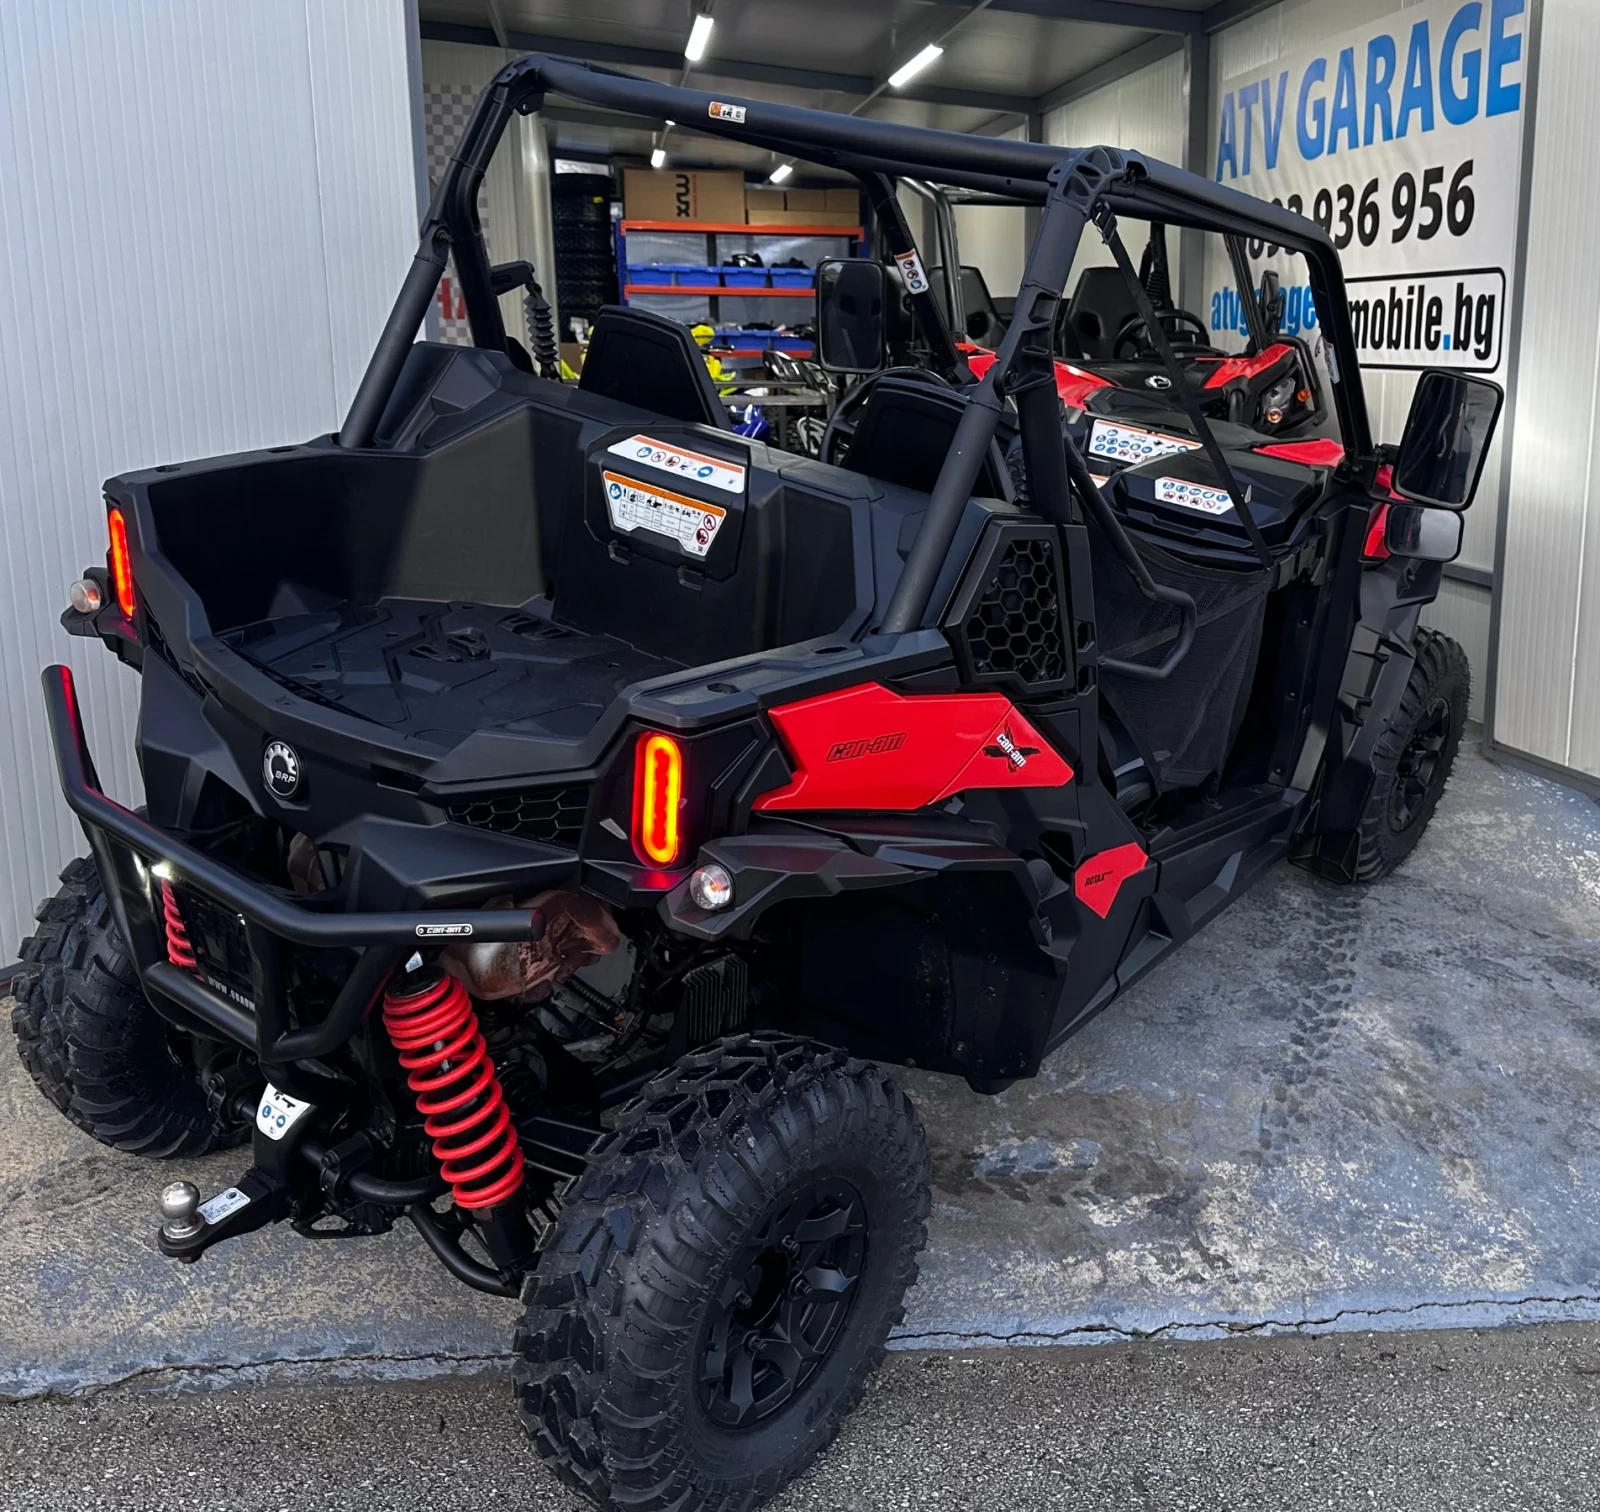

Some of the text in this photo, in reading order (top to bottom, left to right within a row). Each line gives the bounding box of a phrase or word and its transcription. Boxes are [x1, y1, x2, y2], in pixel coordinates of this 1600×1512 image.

[1216, 0, 1525, 183] ATV GARAGE
[1313, 177, 1380, 250] 936
[1391, 159, 1475, 244] 956
[1348, 282, 1496, 361] mobile.bg
[826, 732, 907, 763] can-am
[996, 733, 1027, 768] can-am
[275, 770, 296, 783] BRP
[1084, 872, 1106, 887] ROTAX
[426, 926, 462, 934] can-am
